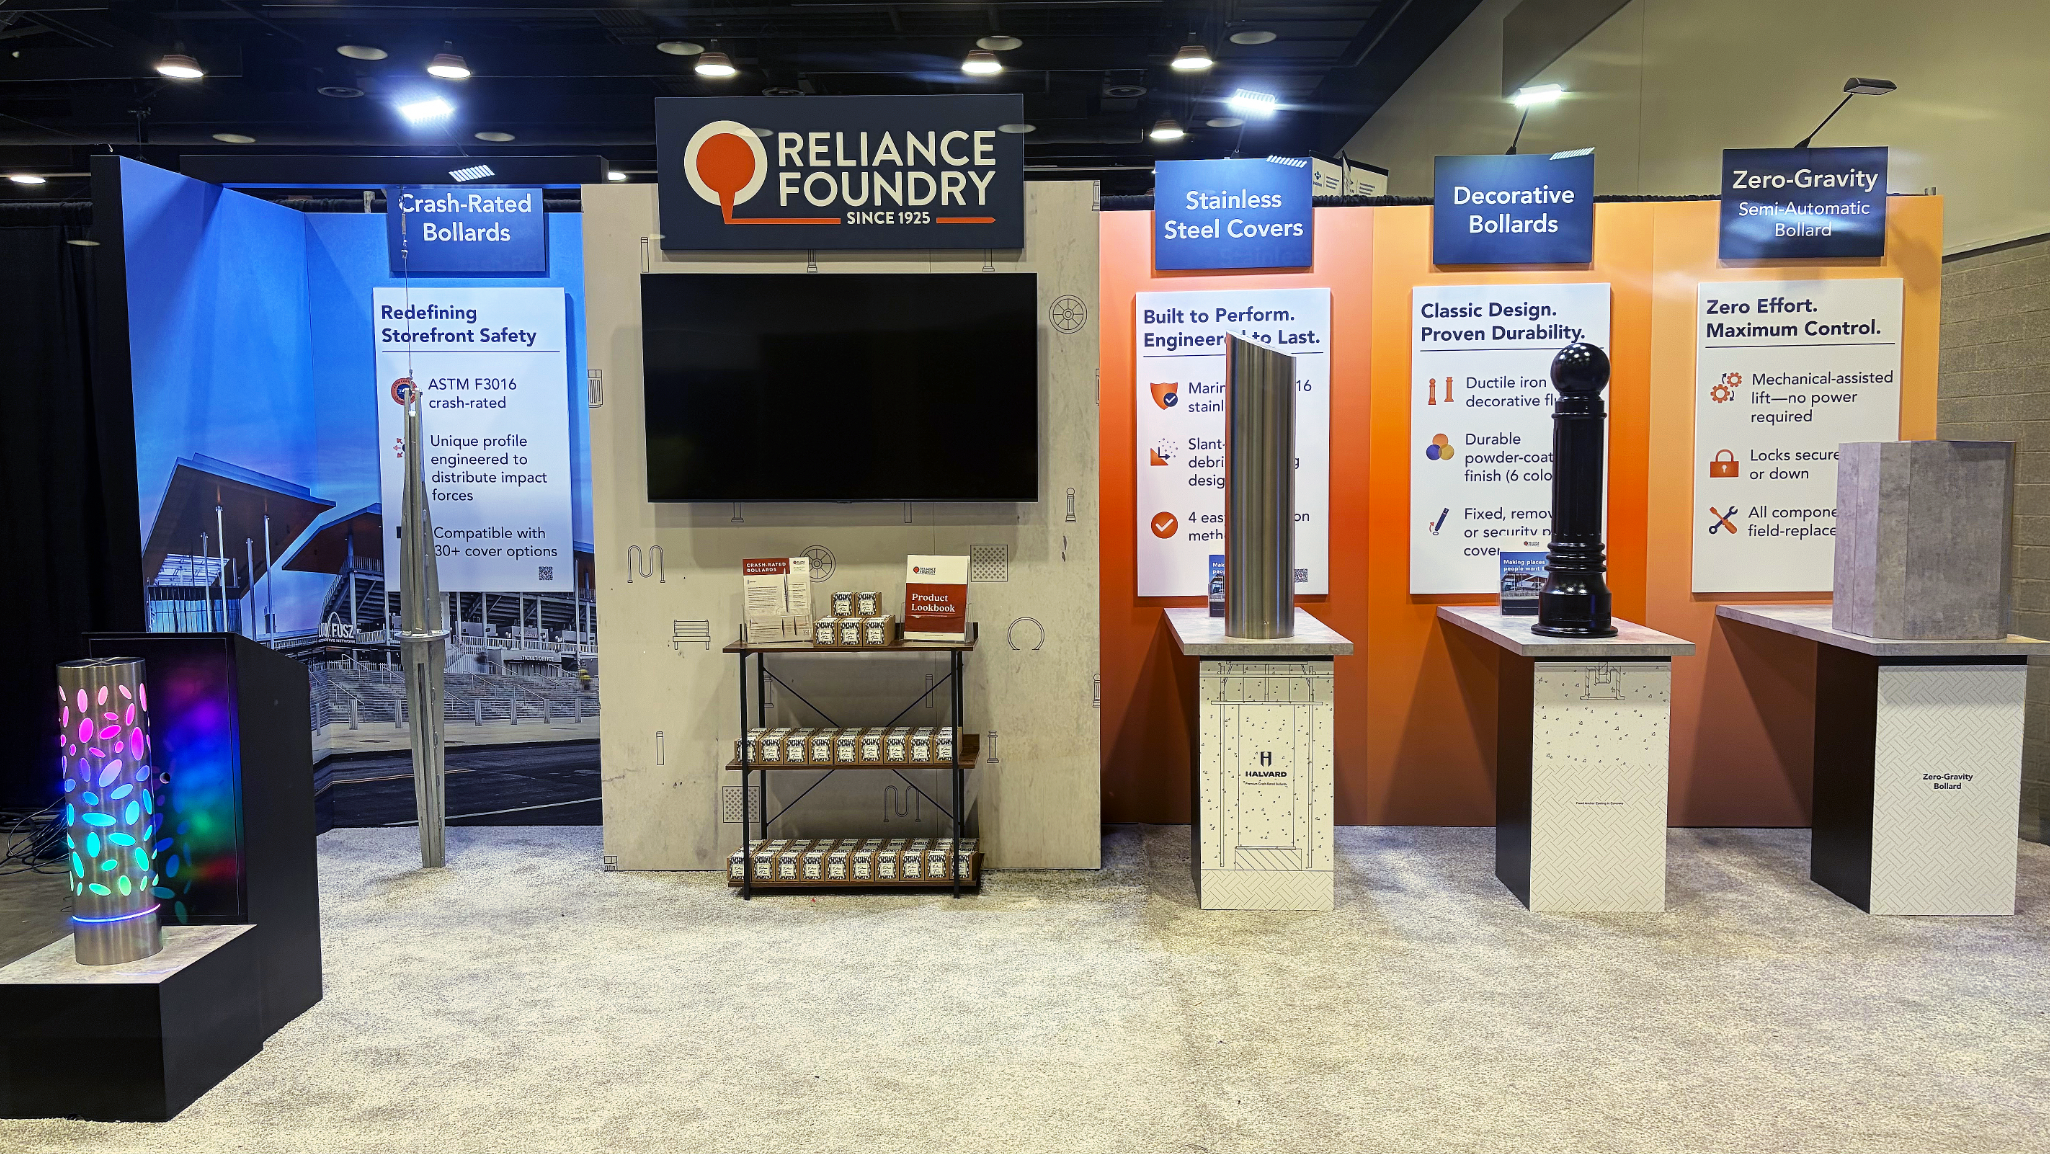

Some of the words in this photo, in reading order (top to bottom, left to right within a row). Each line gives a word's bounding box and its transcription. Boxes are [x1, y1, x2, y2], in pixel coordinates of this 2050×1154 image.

[778, 130, 996, 167] RELIANCE
[1732, 168, 1878, 192] Zero-Gravity
[779, 170, 996, 207] FOUNDRY
[1453, 185, 1575, 205] Decorative
[399, 193, 532, 213] Crash-Rated
[1186, 188, 1282, 210] Stainless
[1738, 200, 1870, 217] Semi-Automatic
[847, 211, 894, 225] SINCE
[898, 211, 931, 225] 1925
[1469, 213, 1559, 234] Bollards
[423, 222, 511, 242] Bollards
[1164, 218, 1220, 240] Steel
[1227, 218, 1304, 238] Covers
[1775, 221, 1832, 237] Bollard
[1421, 302, 1482, 318] Classic
[1488, 302, 1557, 320] Design.
[1706, 299, 1750, 314] Zero
[1757, 297, 1818, 313] Effort.
[381, 305, 477, 324] Redefining
[1144, 309, 1184, 324] Built
[1190, 311, 1209, 323] to
[1215, 306, 1295, 323] Perform.
[1421, 326, 1485, 342] Proven
[1492, 324, 1585, 343] Durability.
[1706, 322, 1798, 338] Maximum
[1804, 319, 1881, 336] Control.
[381, 327, 474, 343] Storefront
[480, 327, 537, 347] Safety
[1144, 329, 1246, 351] Engineer
[1252, 331, 1272, 345] to
[1278, 329, 1320, 345] Last.
[428, 378, 469, 391] ASTM
[475, 378, 517, 391] F3016
[1466, 376, 1515, 388] Ductile
[1520, 376, 1547, 388] iron
[1752, 370, 1894, 385] Mechanical-assisted
[429, 396, 507, 409] crash-rated
[1466, 394, 1540, 407] decorative
[1751, 391, 1806, 404] lift—no
[1811, 393, 1858, 407] power
[1751, 409, 1813, 426] required
[430, 434, 478, 450] Unique
[483, 434, 528, 450] profile
[1465, 432, 1521, 446] Durable
[431, 453, 509, 468] engineered
[514, 453, 528, 465] to
[1750, 449, 1791, 461] Locks
[432, 471, 497, 484] distribute
[501, 471, 548, 487] impact
[1464, 469, 1501, 482] finish
[1506, 469, 1519, 483] (6
[1750, 470, 1765, 479] or
[1769, 467, 1809, 479] down
[432, 488, 474, 502] forces
[1188, 512, 1197, 523] 4
[1201, 514, 1226, 523] eas
[1464, 507, 1506, 521] Fixed,
[1748, 506, 1767, 518] All
[434, 526, 513, 542] Compatible
[517, 526, 546, 539] with
[1188, 528, 1226, 541] meth
[1464, 529, 1479, 538] or
[1483, 526, 1538, 537] security
[434, 544, 461, 557] 30+
[465, 547, 502, 557] cover
[506, 544, 558, 561] options
[911, 593, 949, 602] Product
[911, 603, 956, 613] Lookbook
[331, 623, 354, 638] FUSZ
[1923, 773, 1973, 781] Zero-Gravity
